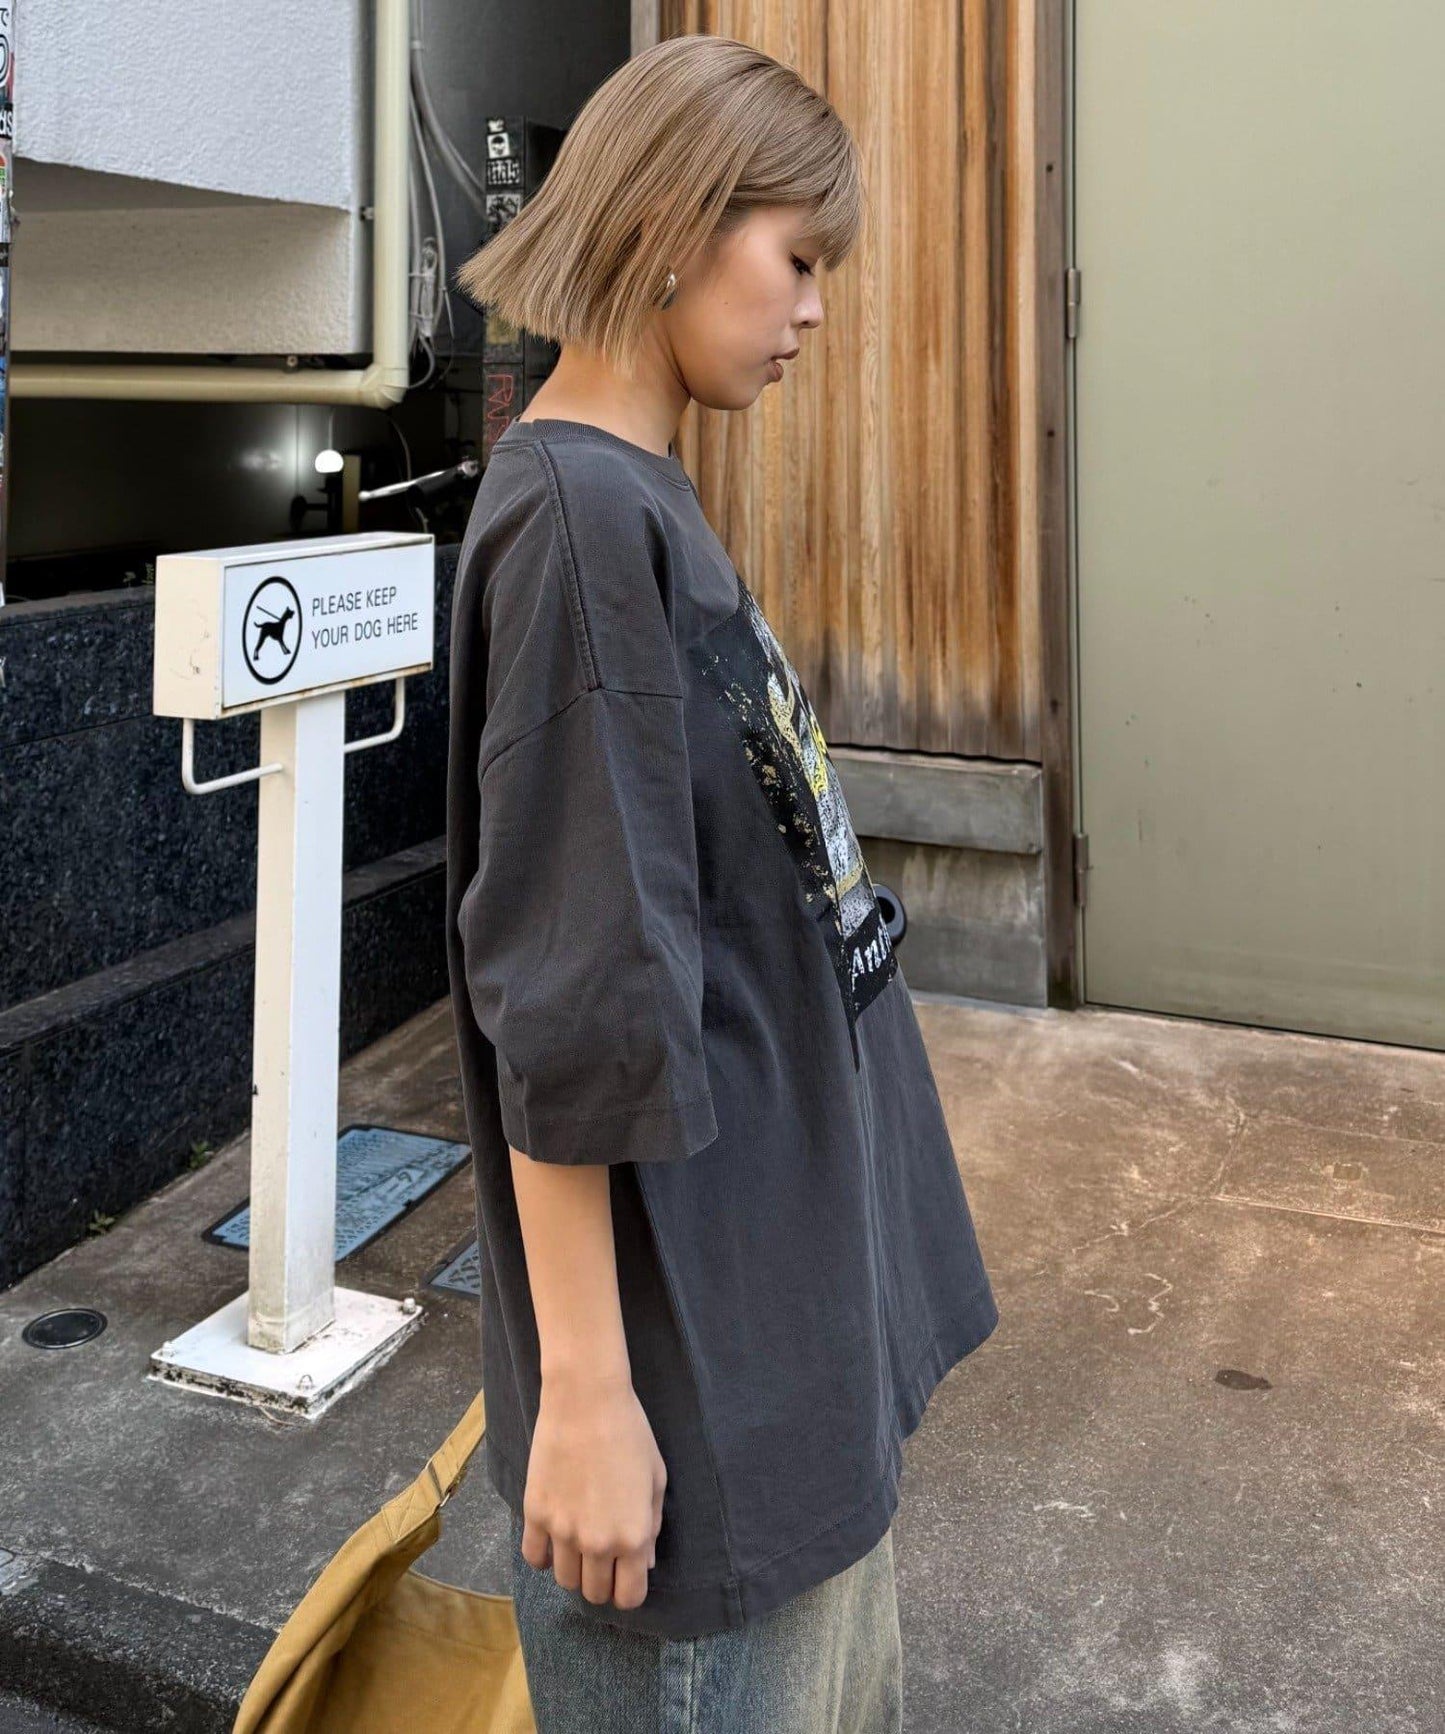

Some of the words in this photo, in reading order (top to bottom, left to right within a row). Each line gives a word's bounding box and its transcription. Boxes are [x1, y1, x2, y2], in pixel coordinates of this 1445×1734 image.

[312, 591, 362, 617] PLEASE
[366, 586, 397, 608] KEEP
[312, 624, 349, 649] YOUR
[354, 619, 382, 641] DOG
[387, 612, 418, 635] HERE
